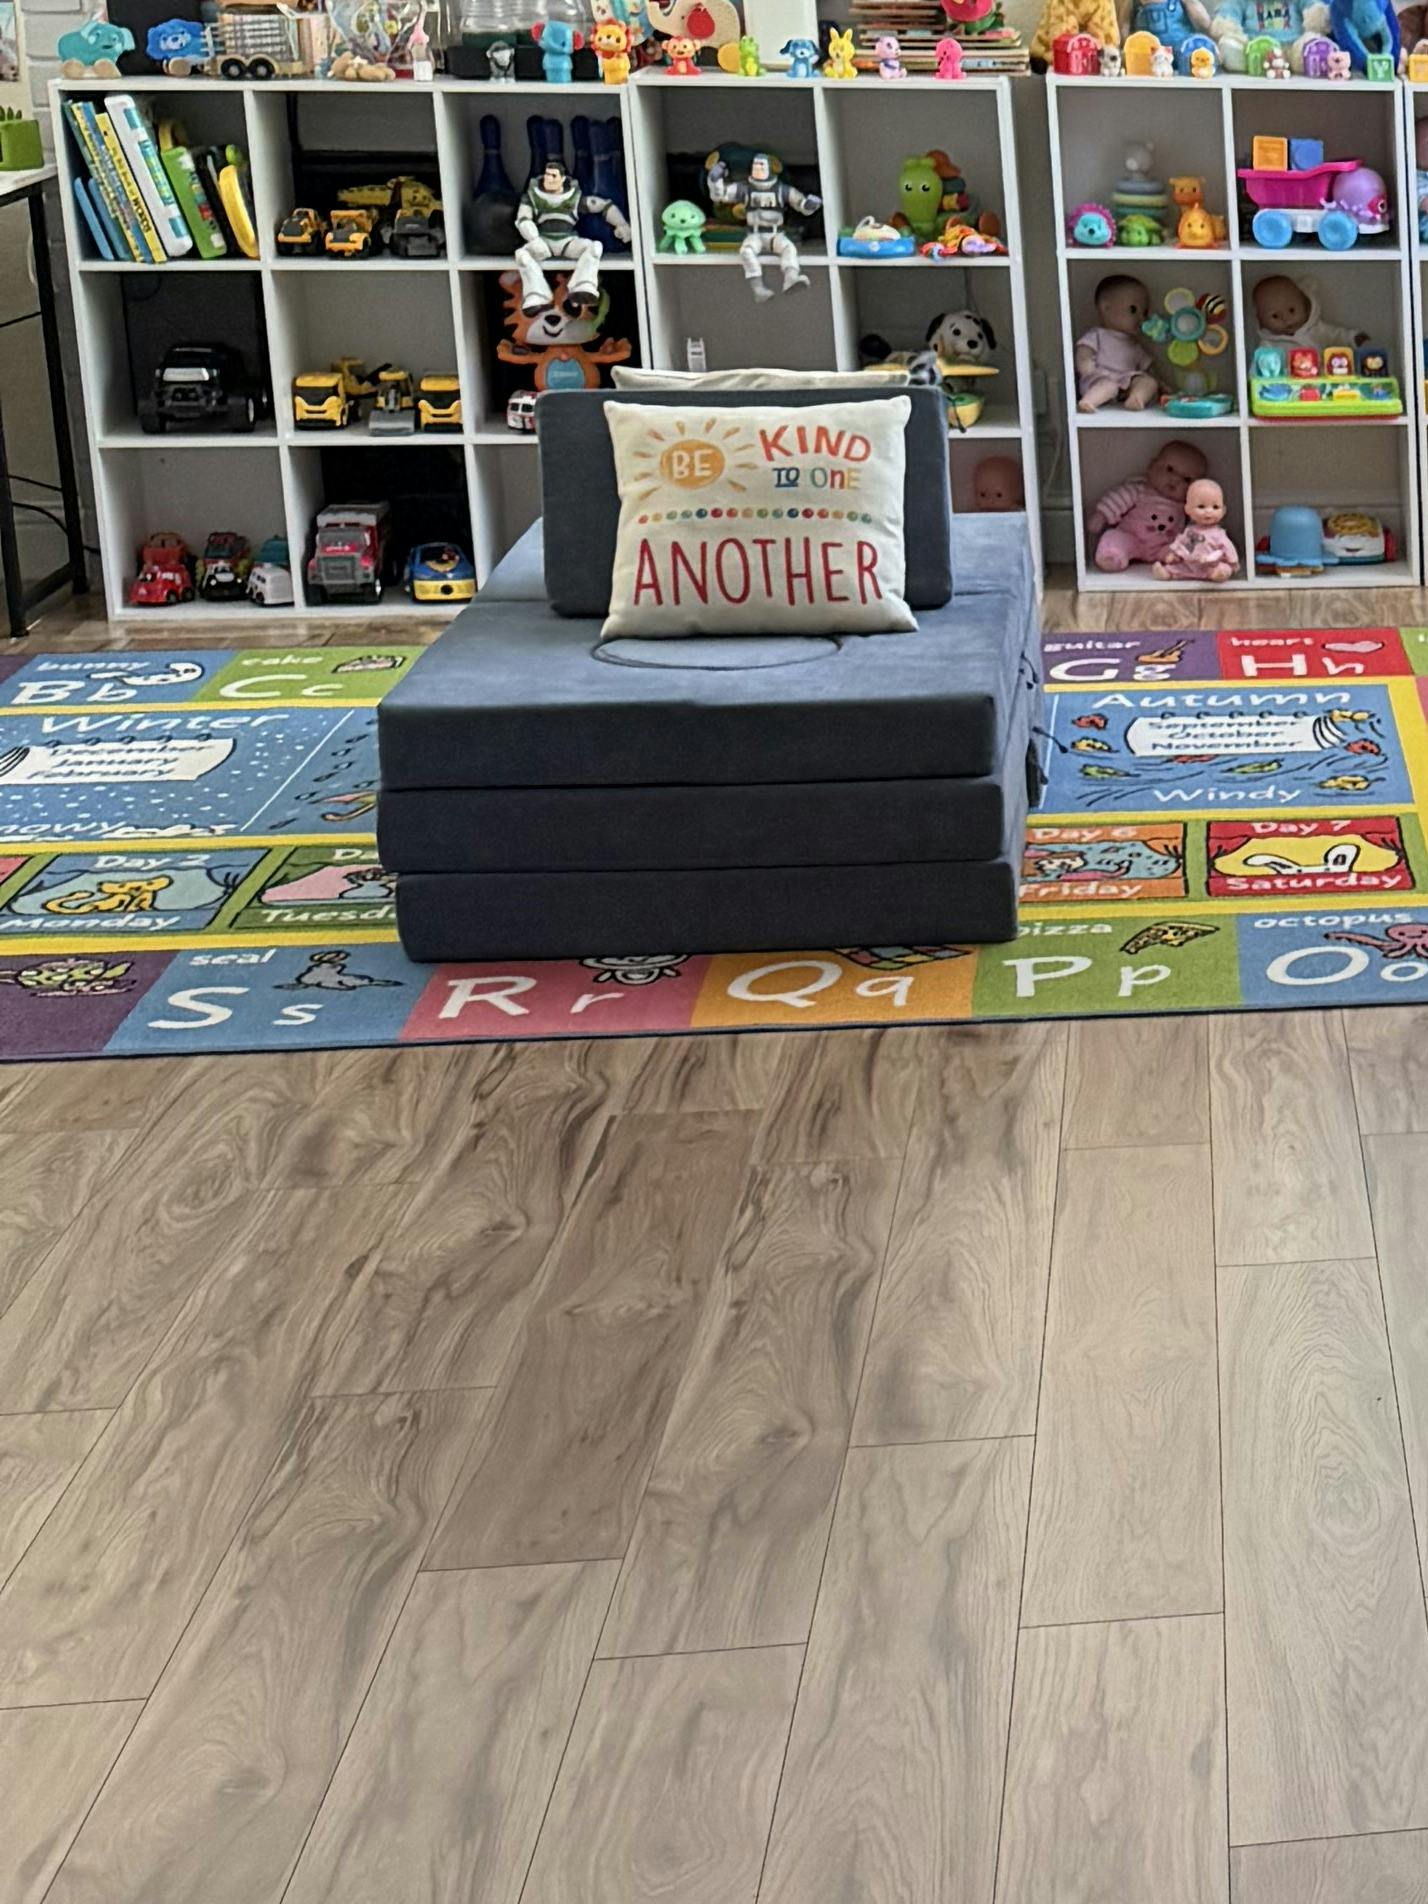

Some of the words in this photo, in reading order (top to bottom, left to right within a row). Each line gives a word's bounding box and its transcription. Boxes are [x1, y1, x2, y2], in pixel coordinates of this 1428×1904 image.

[759, 425, 872, 463] KIND
[671, 448, 714, 479] BE
[773, 466, 800, 487] TO
[633, 536, 883, 606] ANOTHER
[1043, 638, 1142, 652] guitar
[1230, 636, 1315, 647] heart
[36, 661, 150, 672] bunny
[242, 654, 324, 667] cake
[1049, 657, 1122, 682] G
[1240, 654, 1308, 678] H
[1321, 657, 1365, 676] h
[11, 680, 86, 705] B
[87, 682, 138, 702] b
[219, 674, 308, 698] C
[301, 683, 345, 697] c
[1091, 691, 1352, 709] Autumn
[41, 712, 290, 734] Winter
[1148, 719, 1299, 733] September
[1167, 729, 1286, 740] October
[52, 745, 215, 757] December
[1150, 739, 1303, 751] November
[52, 757, 179, 768] January
[26, 768, 176, 779] February
[1153, 785, 1303, 804] Windy
[1033, 827, 1108, 843] Day
[1117, 827, 1139, 839] 6
[1251, 820, 1319, 835] Day
[1326, 820, 1351, 832] 7
[94, 854, 173, 871] Day
[179, 854, 211, 867] 2
[1019, 881, 1143, 898] Friday
[1225, 871, 1403, 891] Saturday
[0, 913, 182, 932] Monday
[1253, 911, 1415, 929] octopus
[190, 949, 278, 966] seal
[1266, 946, 1370, 986] O
[727, 961, 844, 1007] Q
[1002, 955, 1093, 997] P
[1118, 964, 1172, 997] p
[437, 976, 539, 1020] R
[569, 991, 625, 1014] r
[147, 986, 251, 1030] S
[272, 1003, 325, 1026] s
